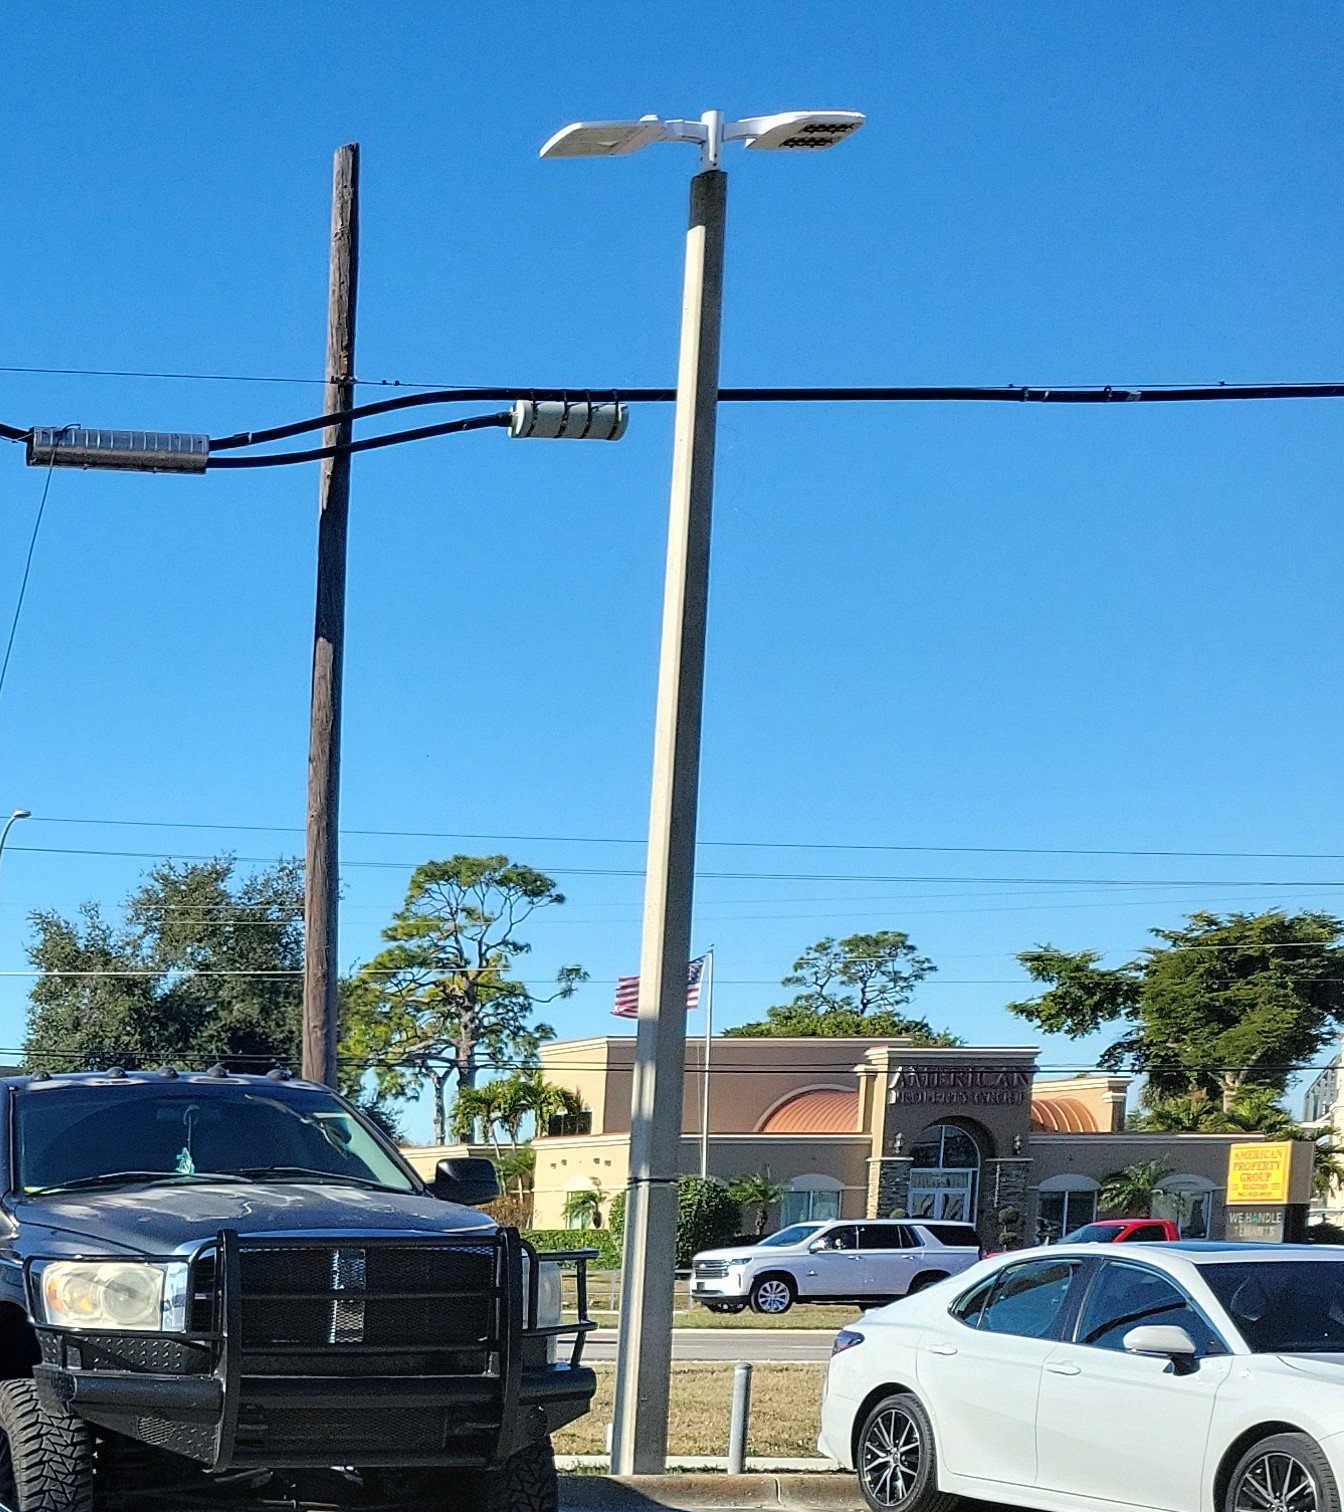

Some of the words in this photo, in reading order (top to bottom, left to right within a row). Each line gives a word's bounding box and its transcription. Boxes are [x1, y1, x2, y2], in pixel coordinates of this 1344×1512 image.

[1234, 1149, 1283, 1159] AMERICAN
[1233, 1161, 1280, 1171] PROPERTY
[1240, 1173, 1272, 1182] GROUP
[1229, 1212, 1244, 1223] WE
[1246, 1212, 1282, 1223] HANDLE
